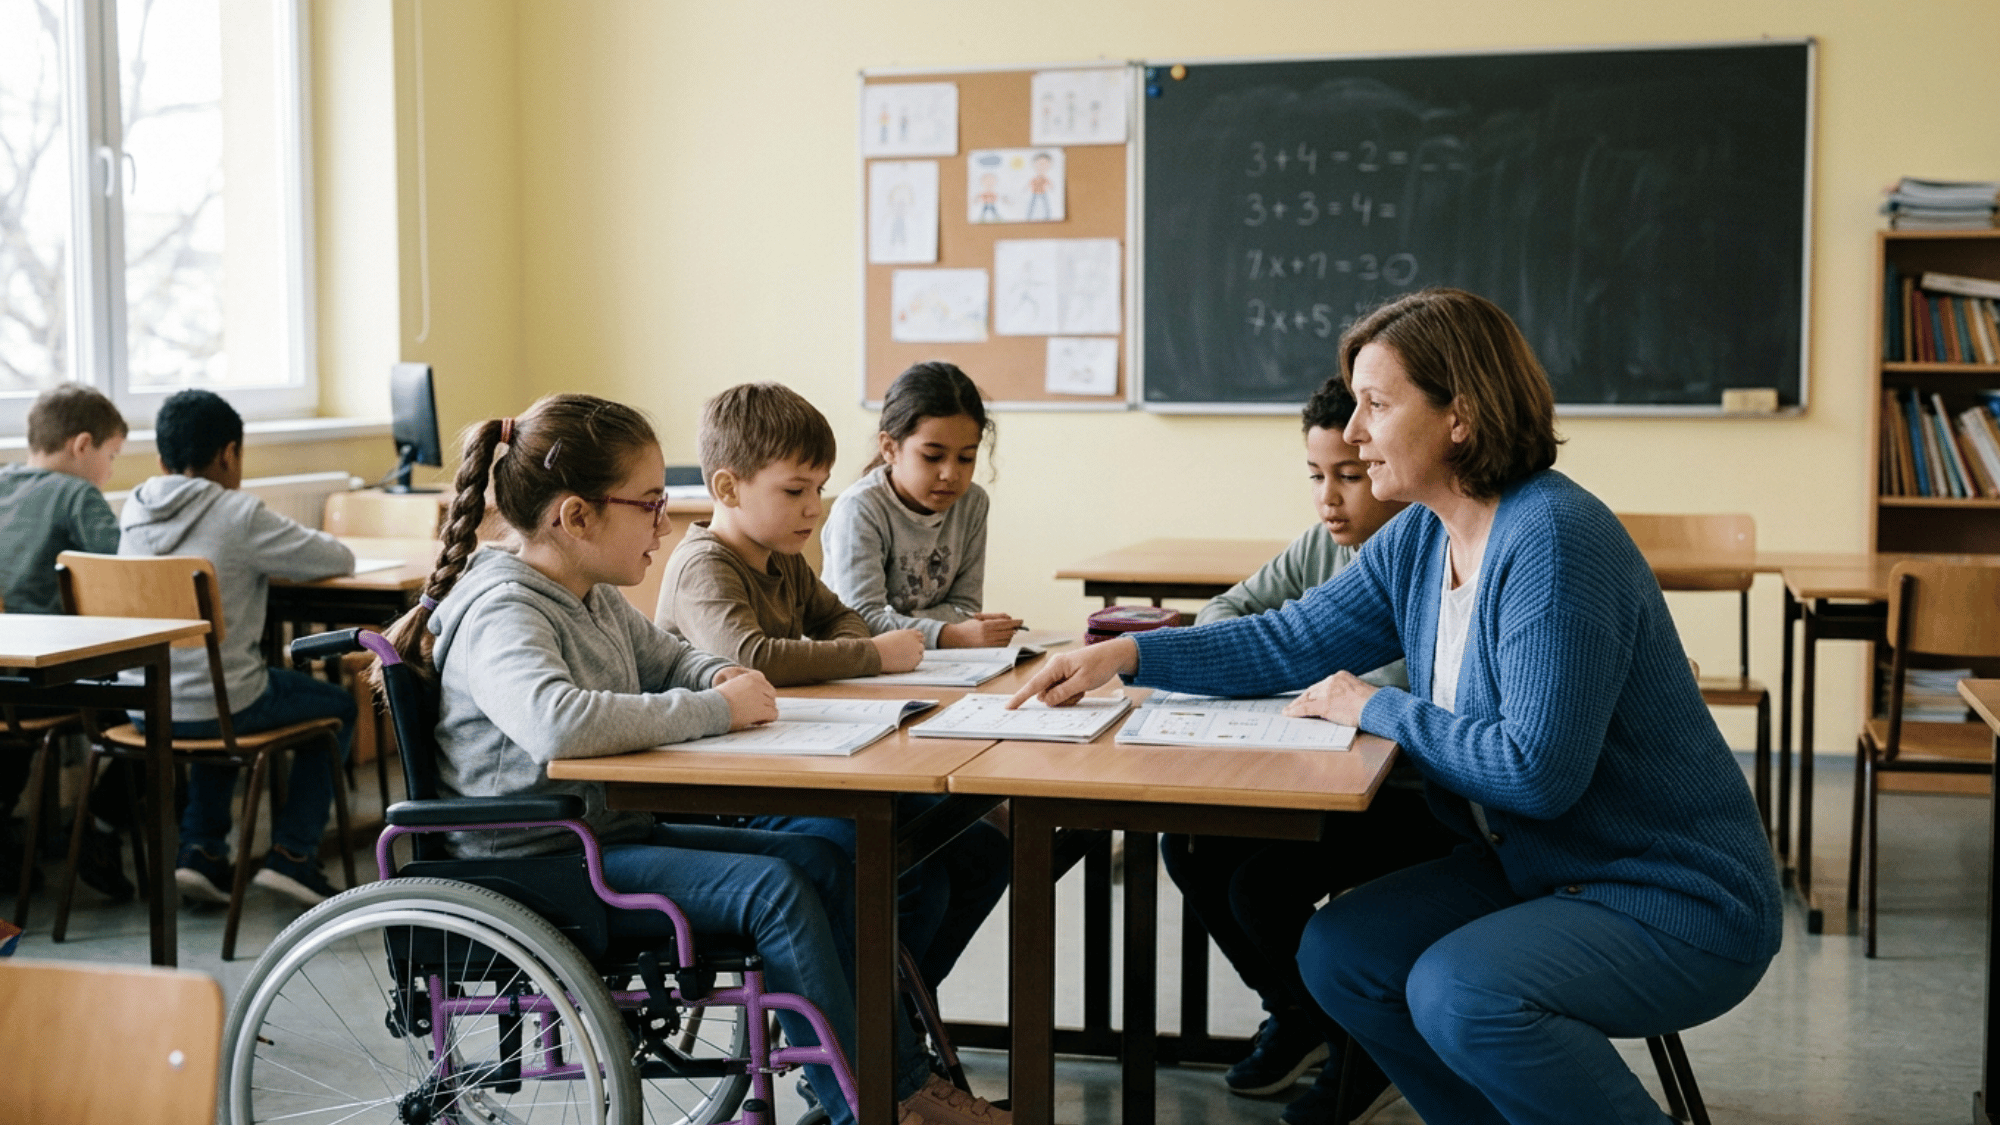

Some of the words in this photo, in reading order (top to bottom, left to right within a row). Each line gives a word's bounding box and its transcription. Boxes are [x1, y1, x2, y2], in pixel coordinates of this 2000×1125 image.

[1246, 141, 1268, 177] 3
[1297, 141, 1318, 175] 4
[1244, 192, 1267, 227] 3
[1272, 201, 1287, 219] +
[1297, 191, 1320, 226] 3
[1328, 202, 1342, 216] =
[1352, 192, 1372, 226] 4
[1378, 203, 1396, 219] =
